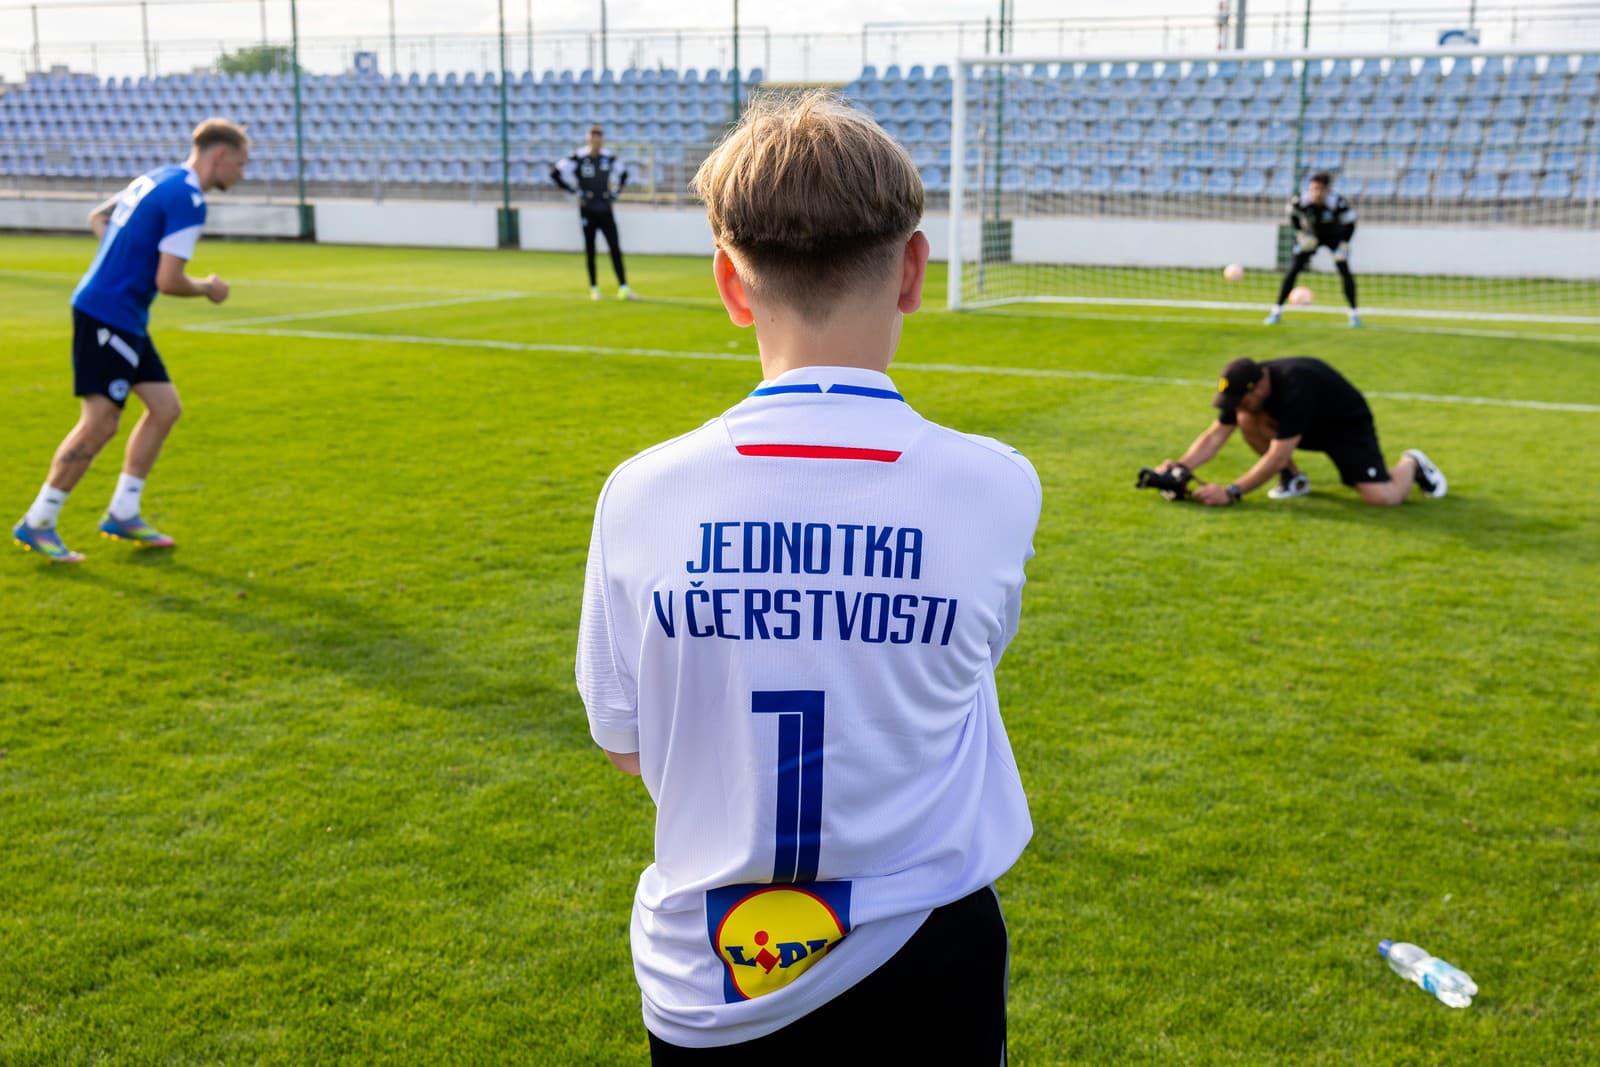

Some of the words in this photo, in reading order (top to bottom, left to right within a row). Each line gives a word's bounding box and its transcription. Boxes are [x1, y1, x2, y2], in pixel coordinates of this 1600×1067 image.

[686, 522, 923, 580] JEDNOTKA
[653, 590, 676, 638] V
[685, 581, 957, 646] ČERSTVOSTI
[751, 690, 825, 884] 1
